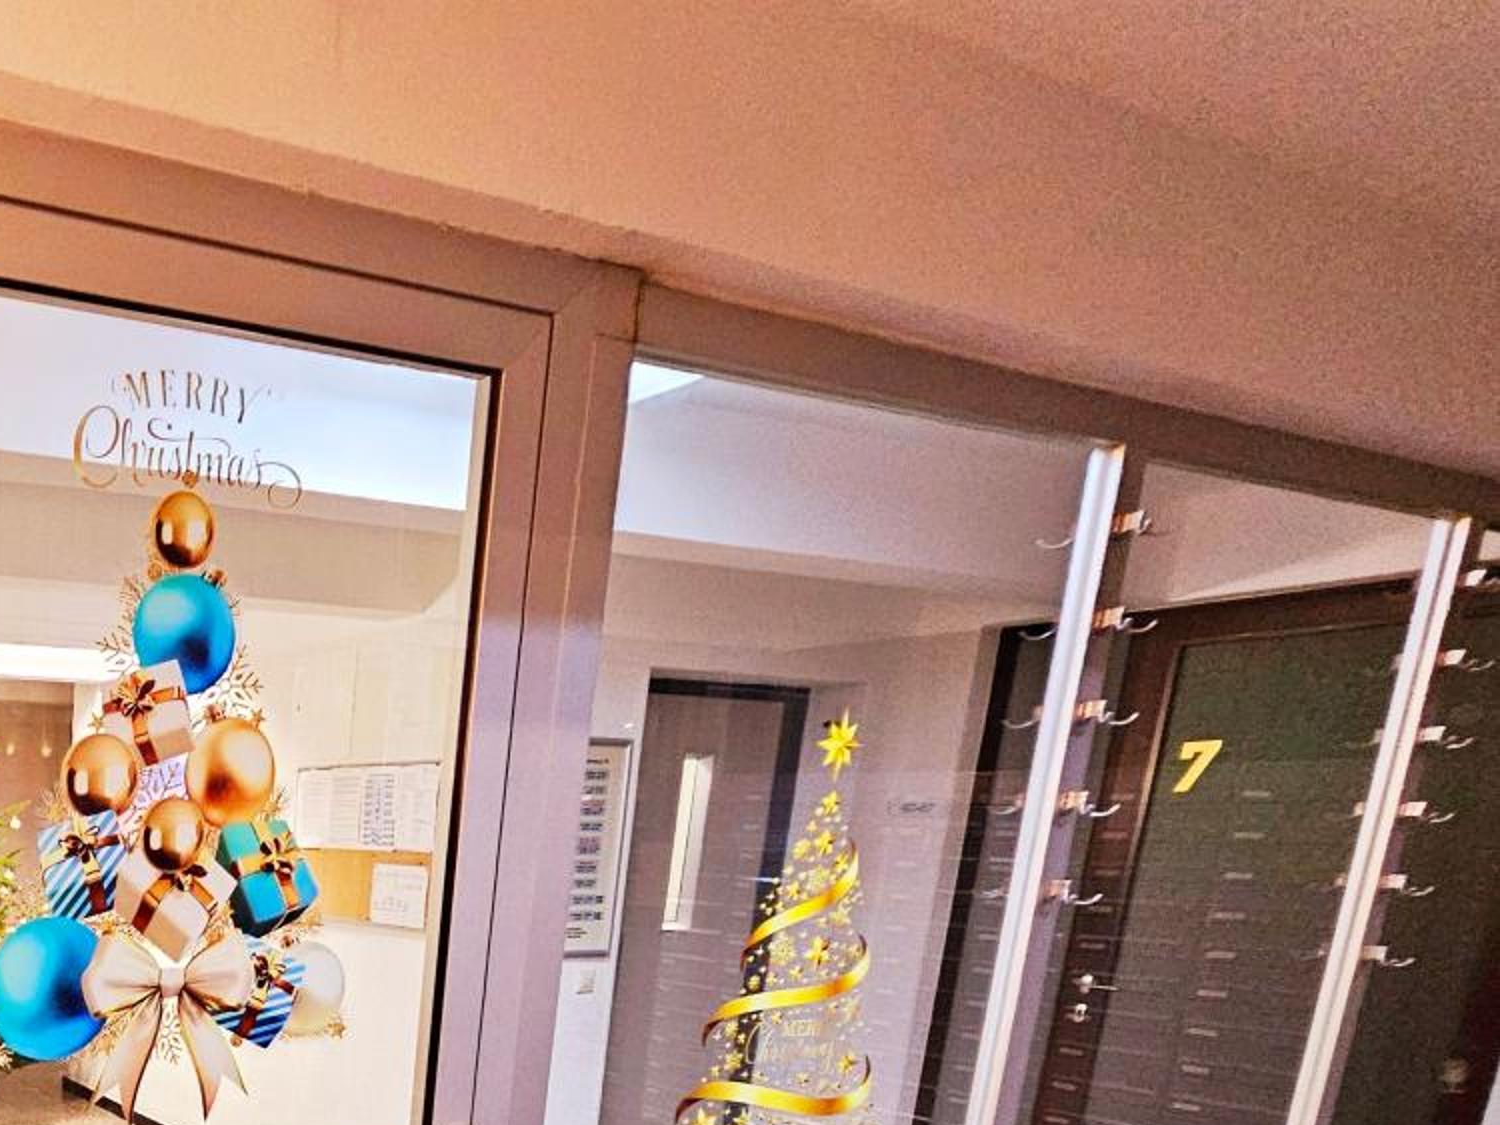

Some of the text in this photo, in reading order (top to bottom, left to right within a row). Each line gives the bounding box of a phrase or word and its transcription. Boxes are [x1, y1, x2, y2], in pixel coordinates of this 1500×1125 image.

[121, 369, 264, 424] MERRY
[73, 405, 302, 509] Christmas
[1173, 739, 1222, 793] 7
